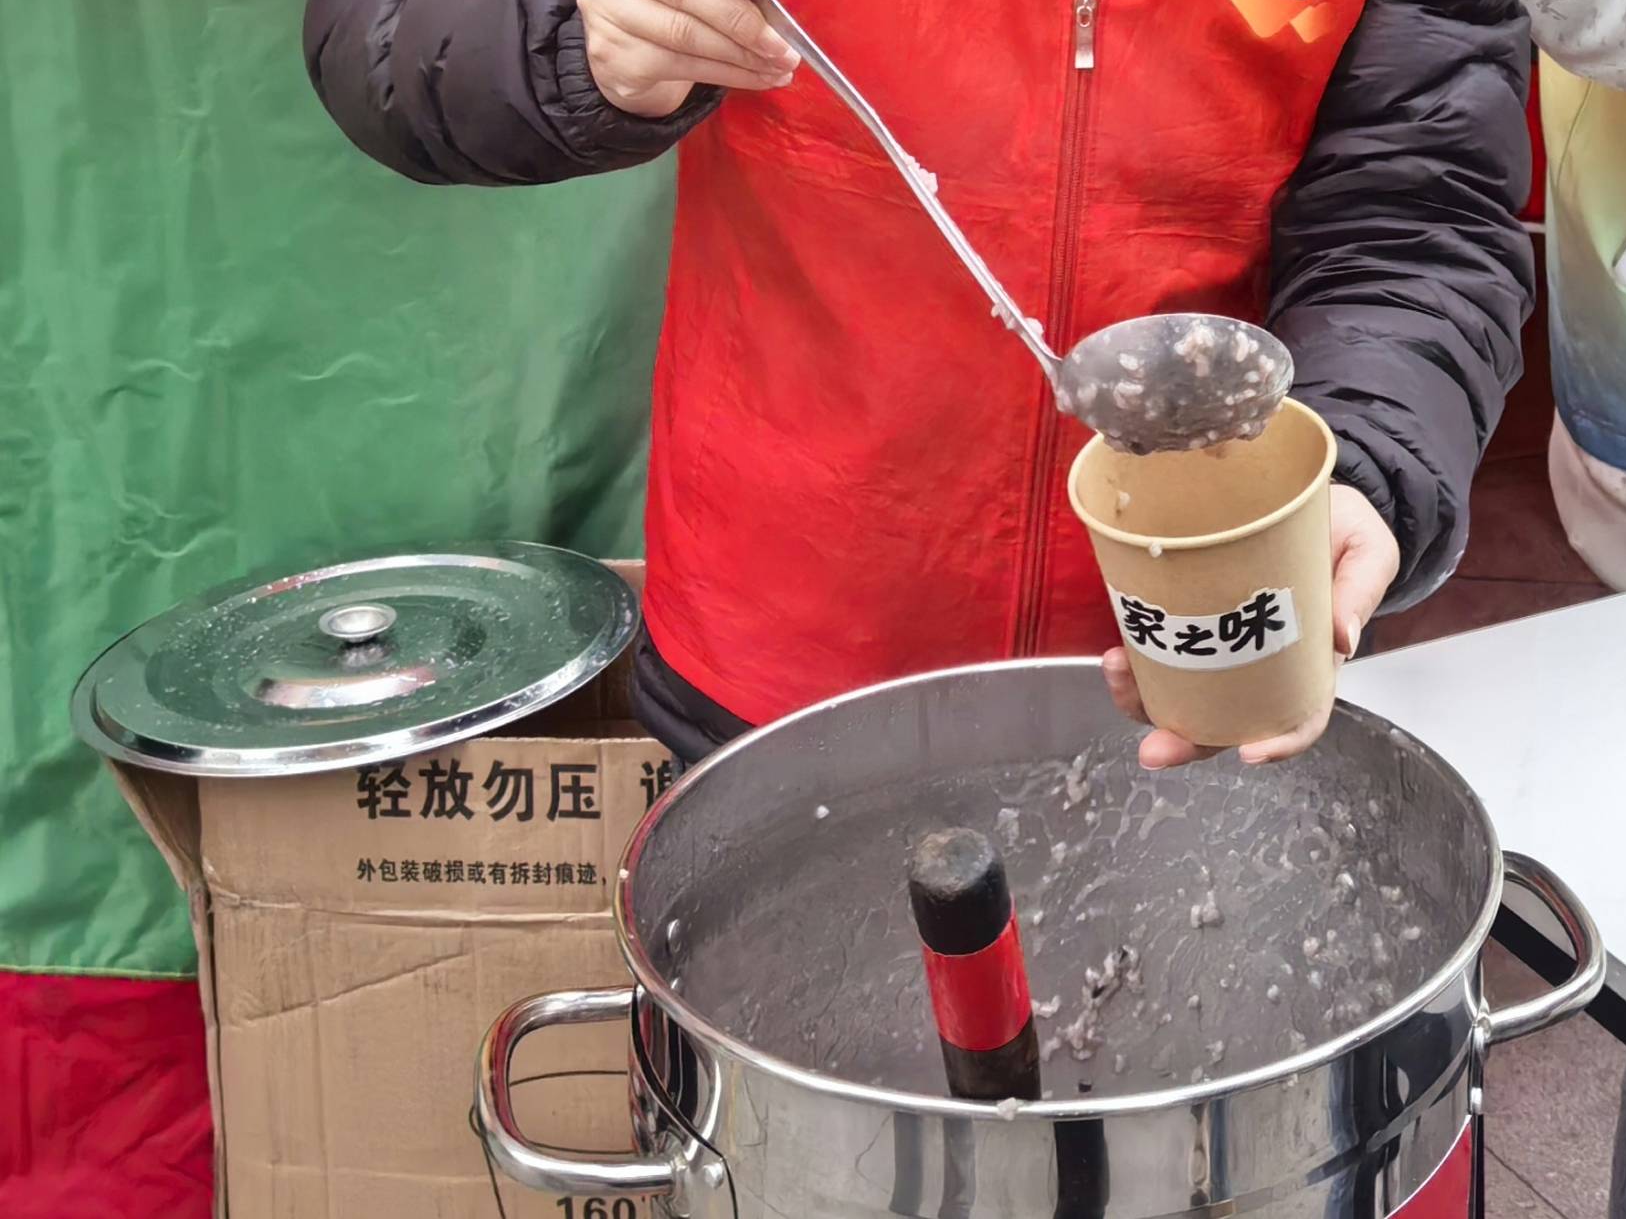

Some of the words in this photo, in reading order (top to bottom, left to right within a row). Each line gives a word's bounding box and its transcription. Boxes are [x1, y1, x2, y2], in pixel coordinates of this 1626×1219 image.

[1121, 591, 1286, 657] 家之味
[356, 758, 601, 822] 轻放勿压
